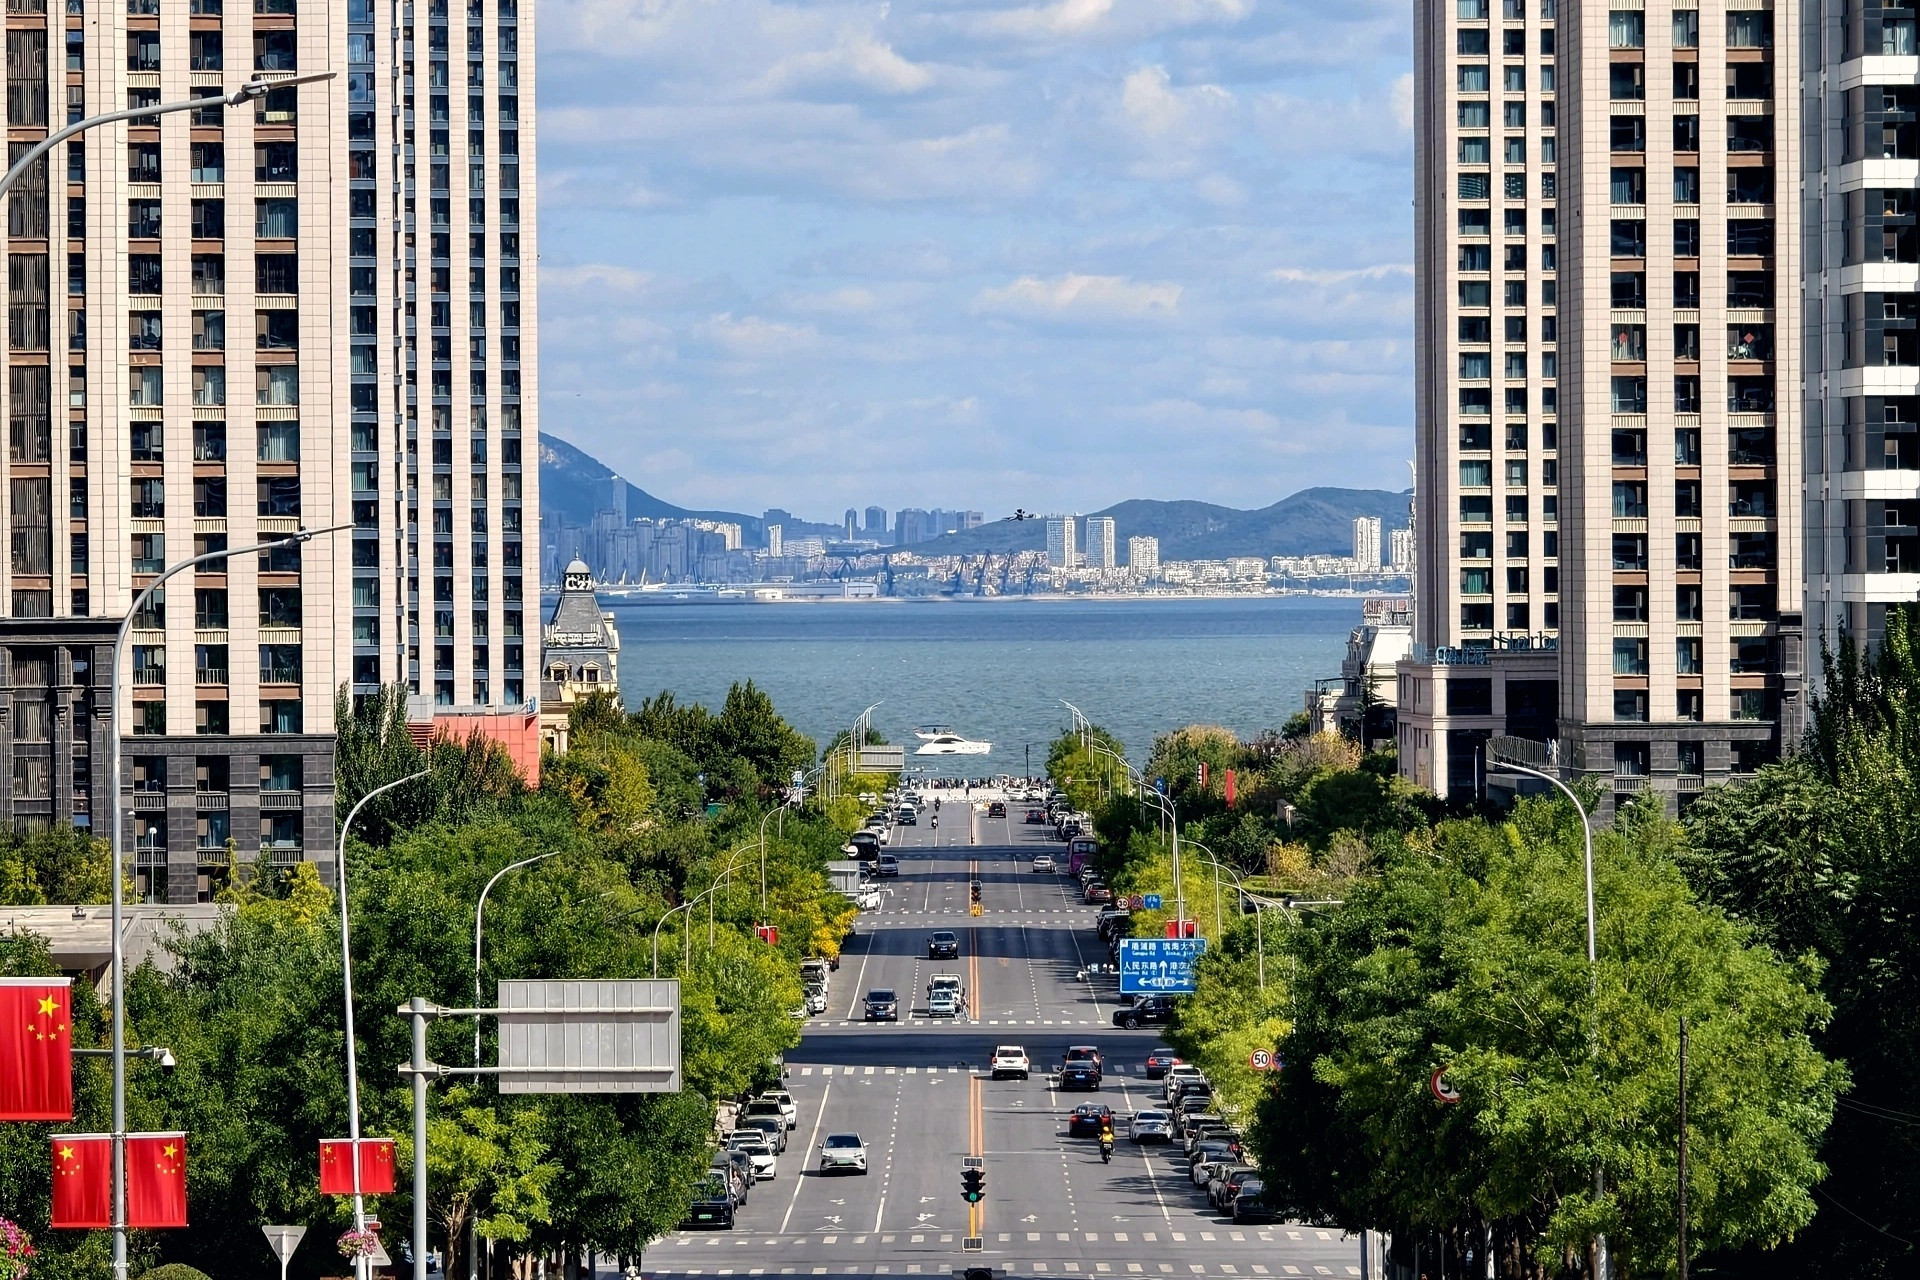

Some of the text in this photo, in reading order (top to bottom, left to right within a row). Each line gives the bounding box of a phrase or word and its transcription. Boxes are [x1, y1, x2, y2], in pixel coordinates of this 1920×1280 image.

[1124, 962, 1157, 970] 人民东路
[1254, 1053, 1268, 1065] 50
